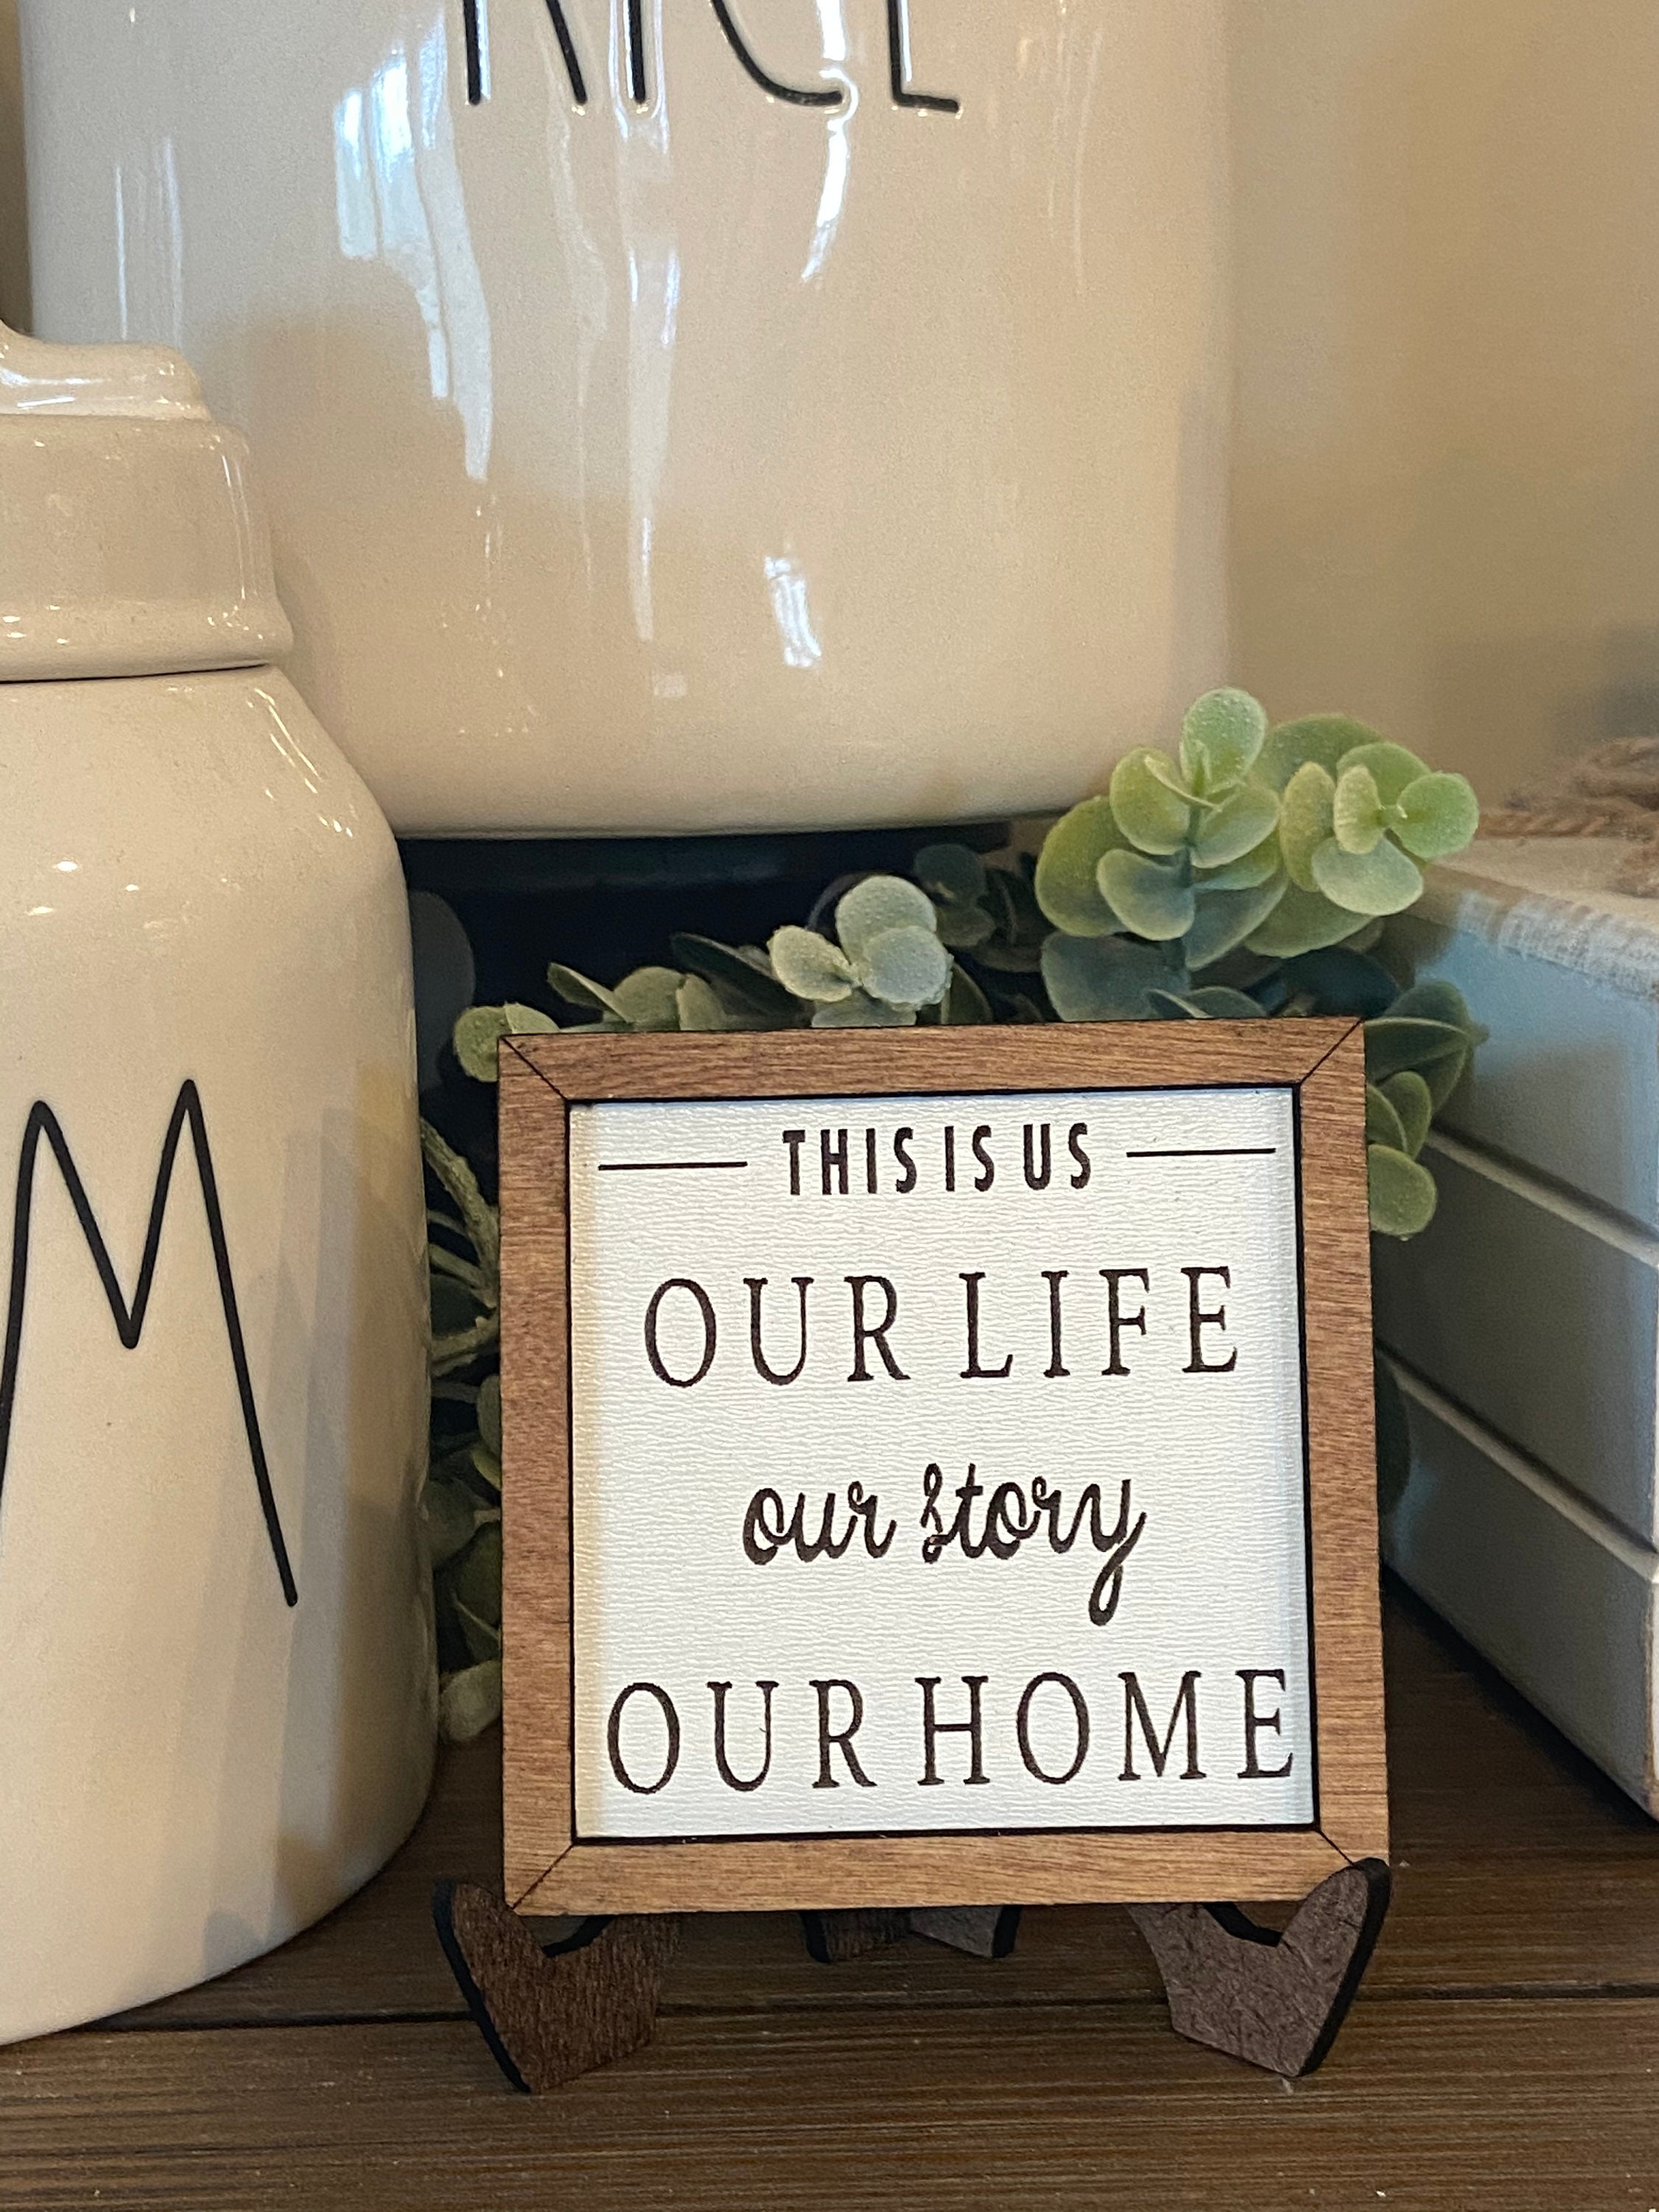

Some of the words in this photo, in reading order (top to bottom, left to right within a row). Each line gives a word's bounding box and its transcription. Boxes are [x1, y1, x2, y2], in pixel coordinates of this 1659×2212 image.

[782, 1127, 917, 1196] THIS
[944, 1124, 995, 1192] IS
[1023, 1122, 1091, 1191] US
[644, 1275, 911, 1388] OUR
[959, 1265, 1237, 1379] LIFE
[742, 1481, 897, 1565] our
[919, 1462, 1147, 1627] story
[607, 1679, 877, 1795] OUR
[914, 1668, 1293, 1786] HOME
